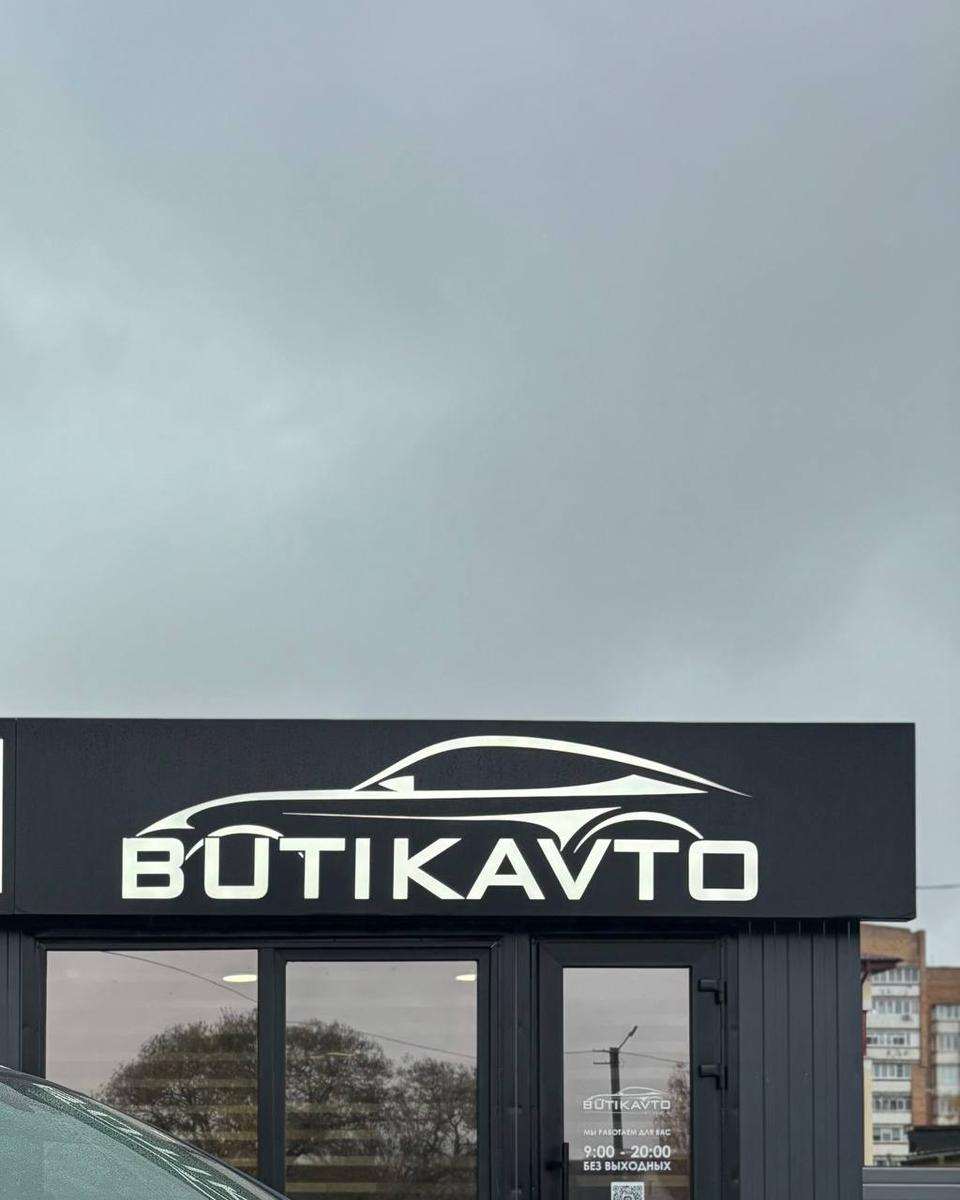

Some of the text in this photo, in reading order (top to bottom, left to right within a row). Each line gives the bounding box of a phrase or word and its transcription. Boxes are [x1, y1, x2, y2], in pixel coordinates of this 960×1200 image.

[121, 836, 759, 902] BUTIKAVTO
[583, 1100, 671, 1110] BUTIKAVTO
[584, 1145, 615, 1158] 9:00
[631, 1145, 671, 1158] 20:00
[584, 1161, 671, 1172] БЕЗ ВЫХОДНЫХ
